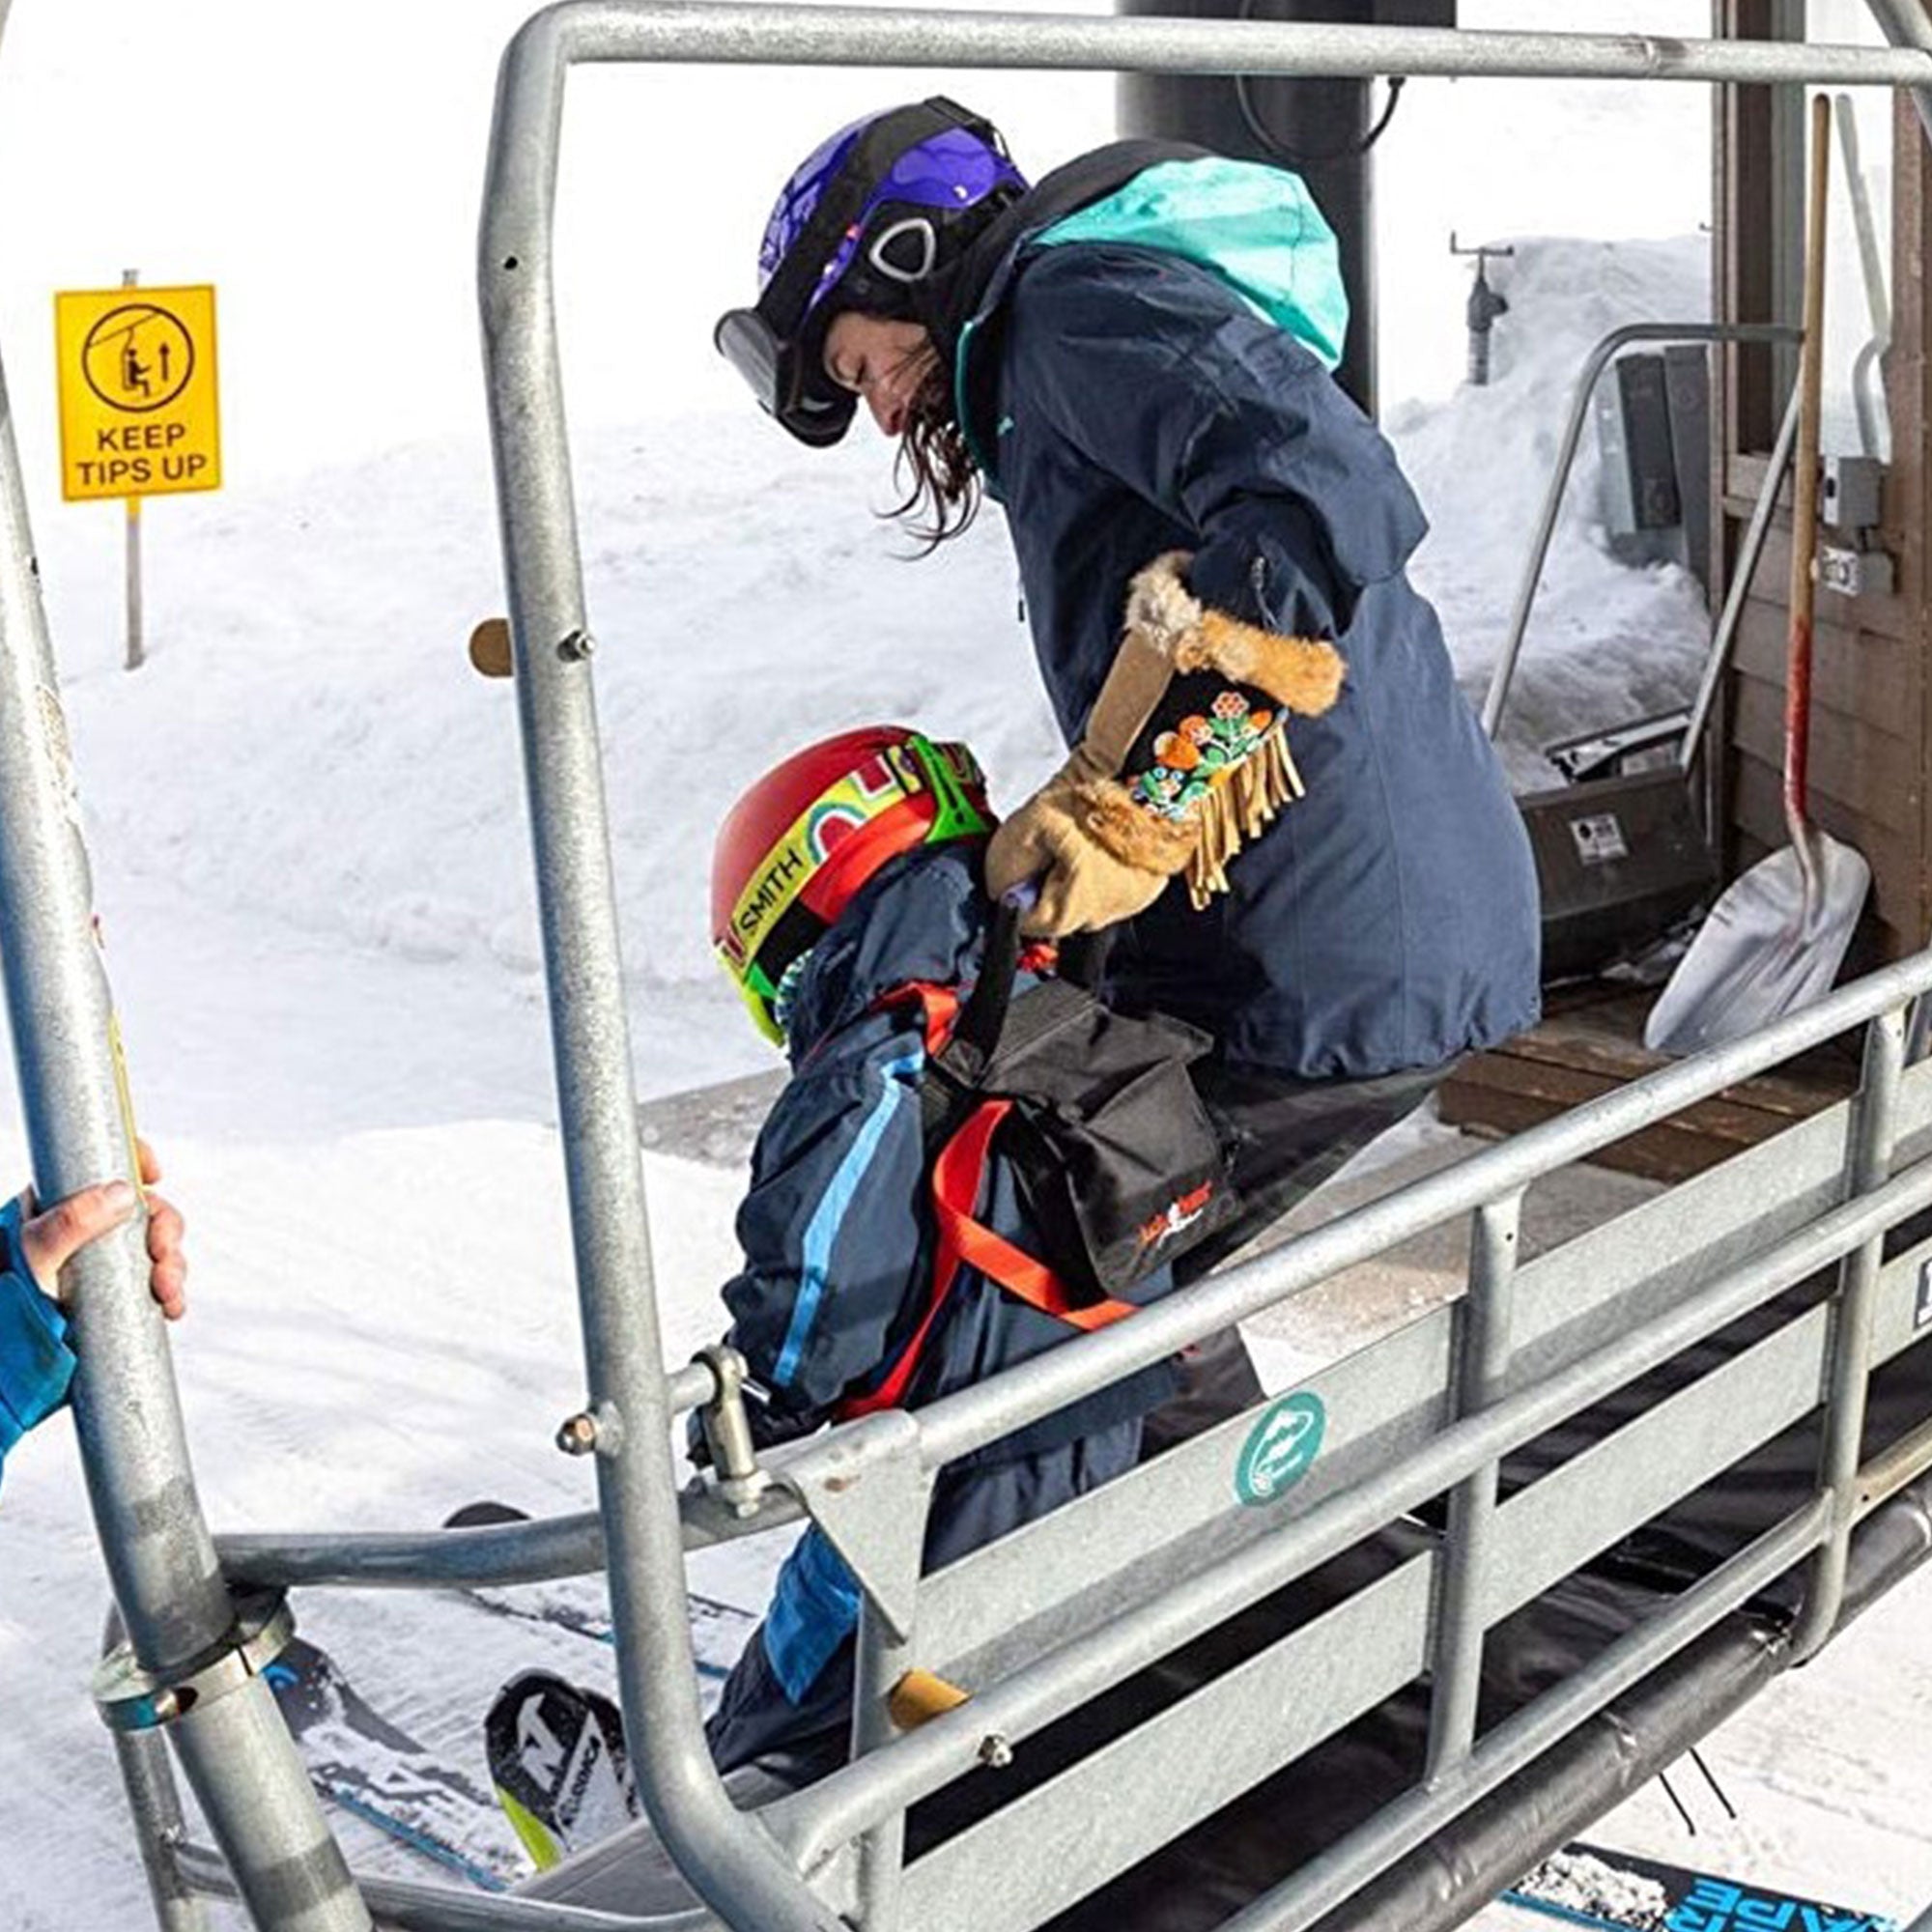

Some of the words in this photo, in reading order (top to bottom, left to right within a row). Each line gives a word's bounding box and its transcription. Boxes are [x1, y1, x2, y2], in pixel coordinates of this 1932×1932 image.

[98, 423, 185, 451] KEEP
[76, 458, 152, 485] TIPS
[162, 454, 207, 480] UP
[740, 848, 804, 929] SMITH
